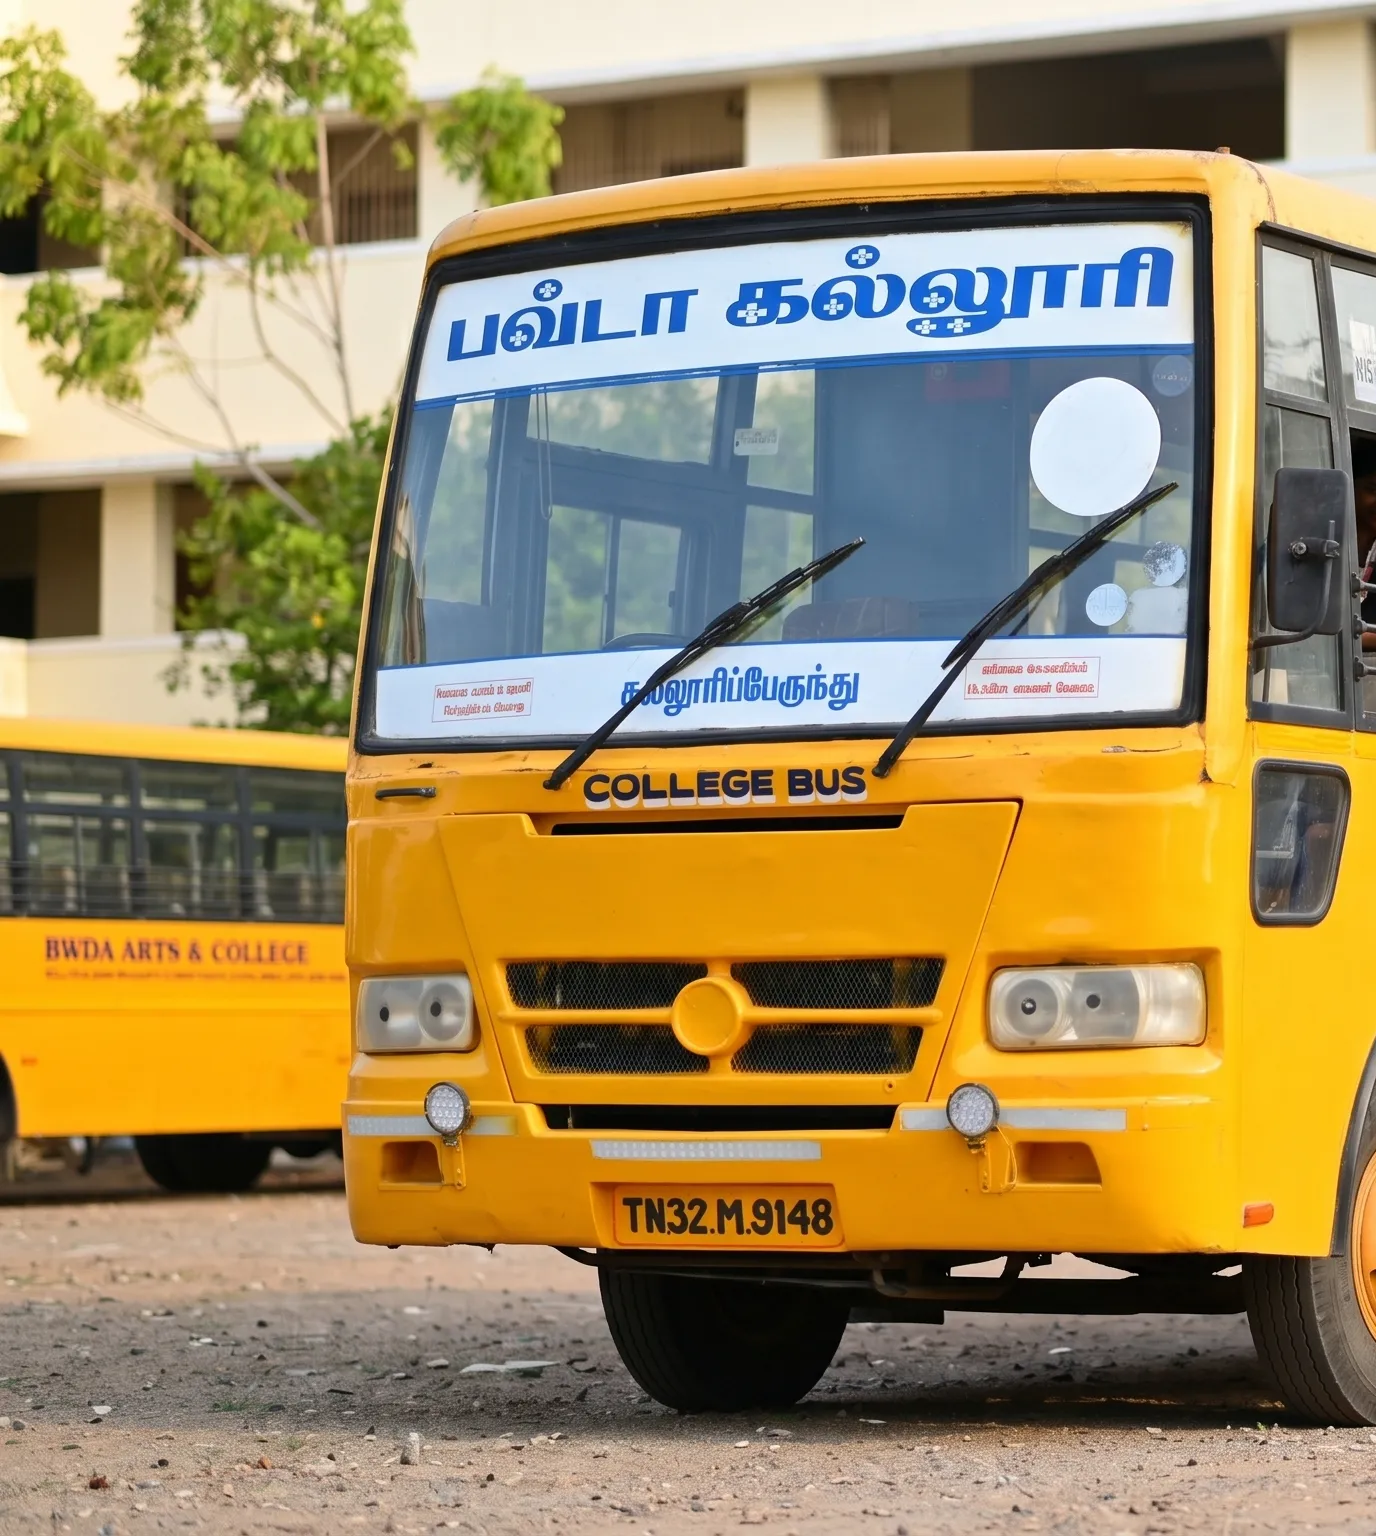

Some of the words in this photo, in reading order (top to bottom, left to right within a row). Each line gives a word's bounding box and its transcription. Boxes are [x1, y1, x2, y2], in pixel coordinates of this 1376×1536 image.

[447, 278, 698, 361] பவ்டா
[725, 245, 1174, 338] கல்லூரி
[583, 767, 776, 809] COLLEGE
[787, 765, 868, 803] BUS
[45, 938, 114, 961] BWDA
[122, 939, 180, 962] ARTS
[188, 942, 203, 962] &
